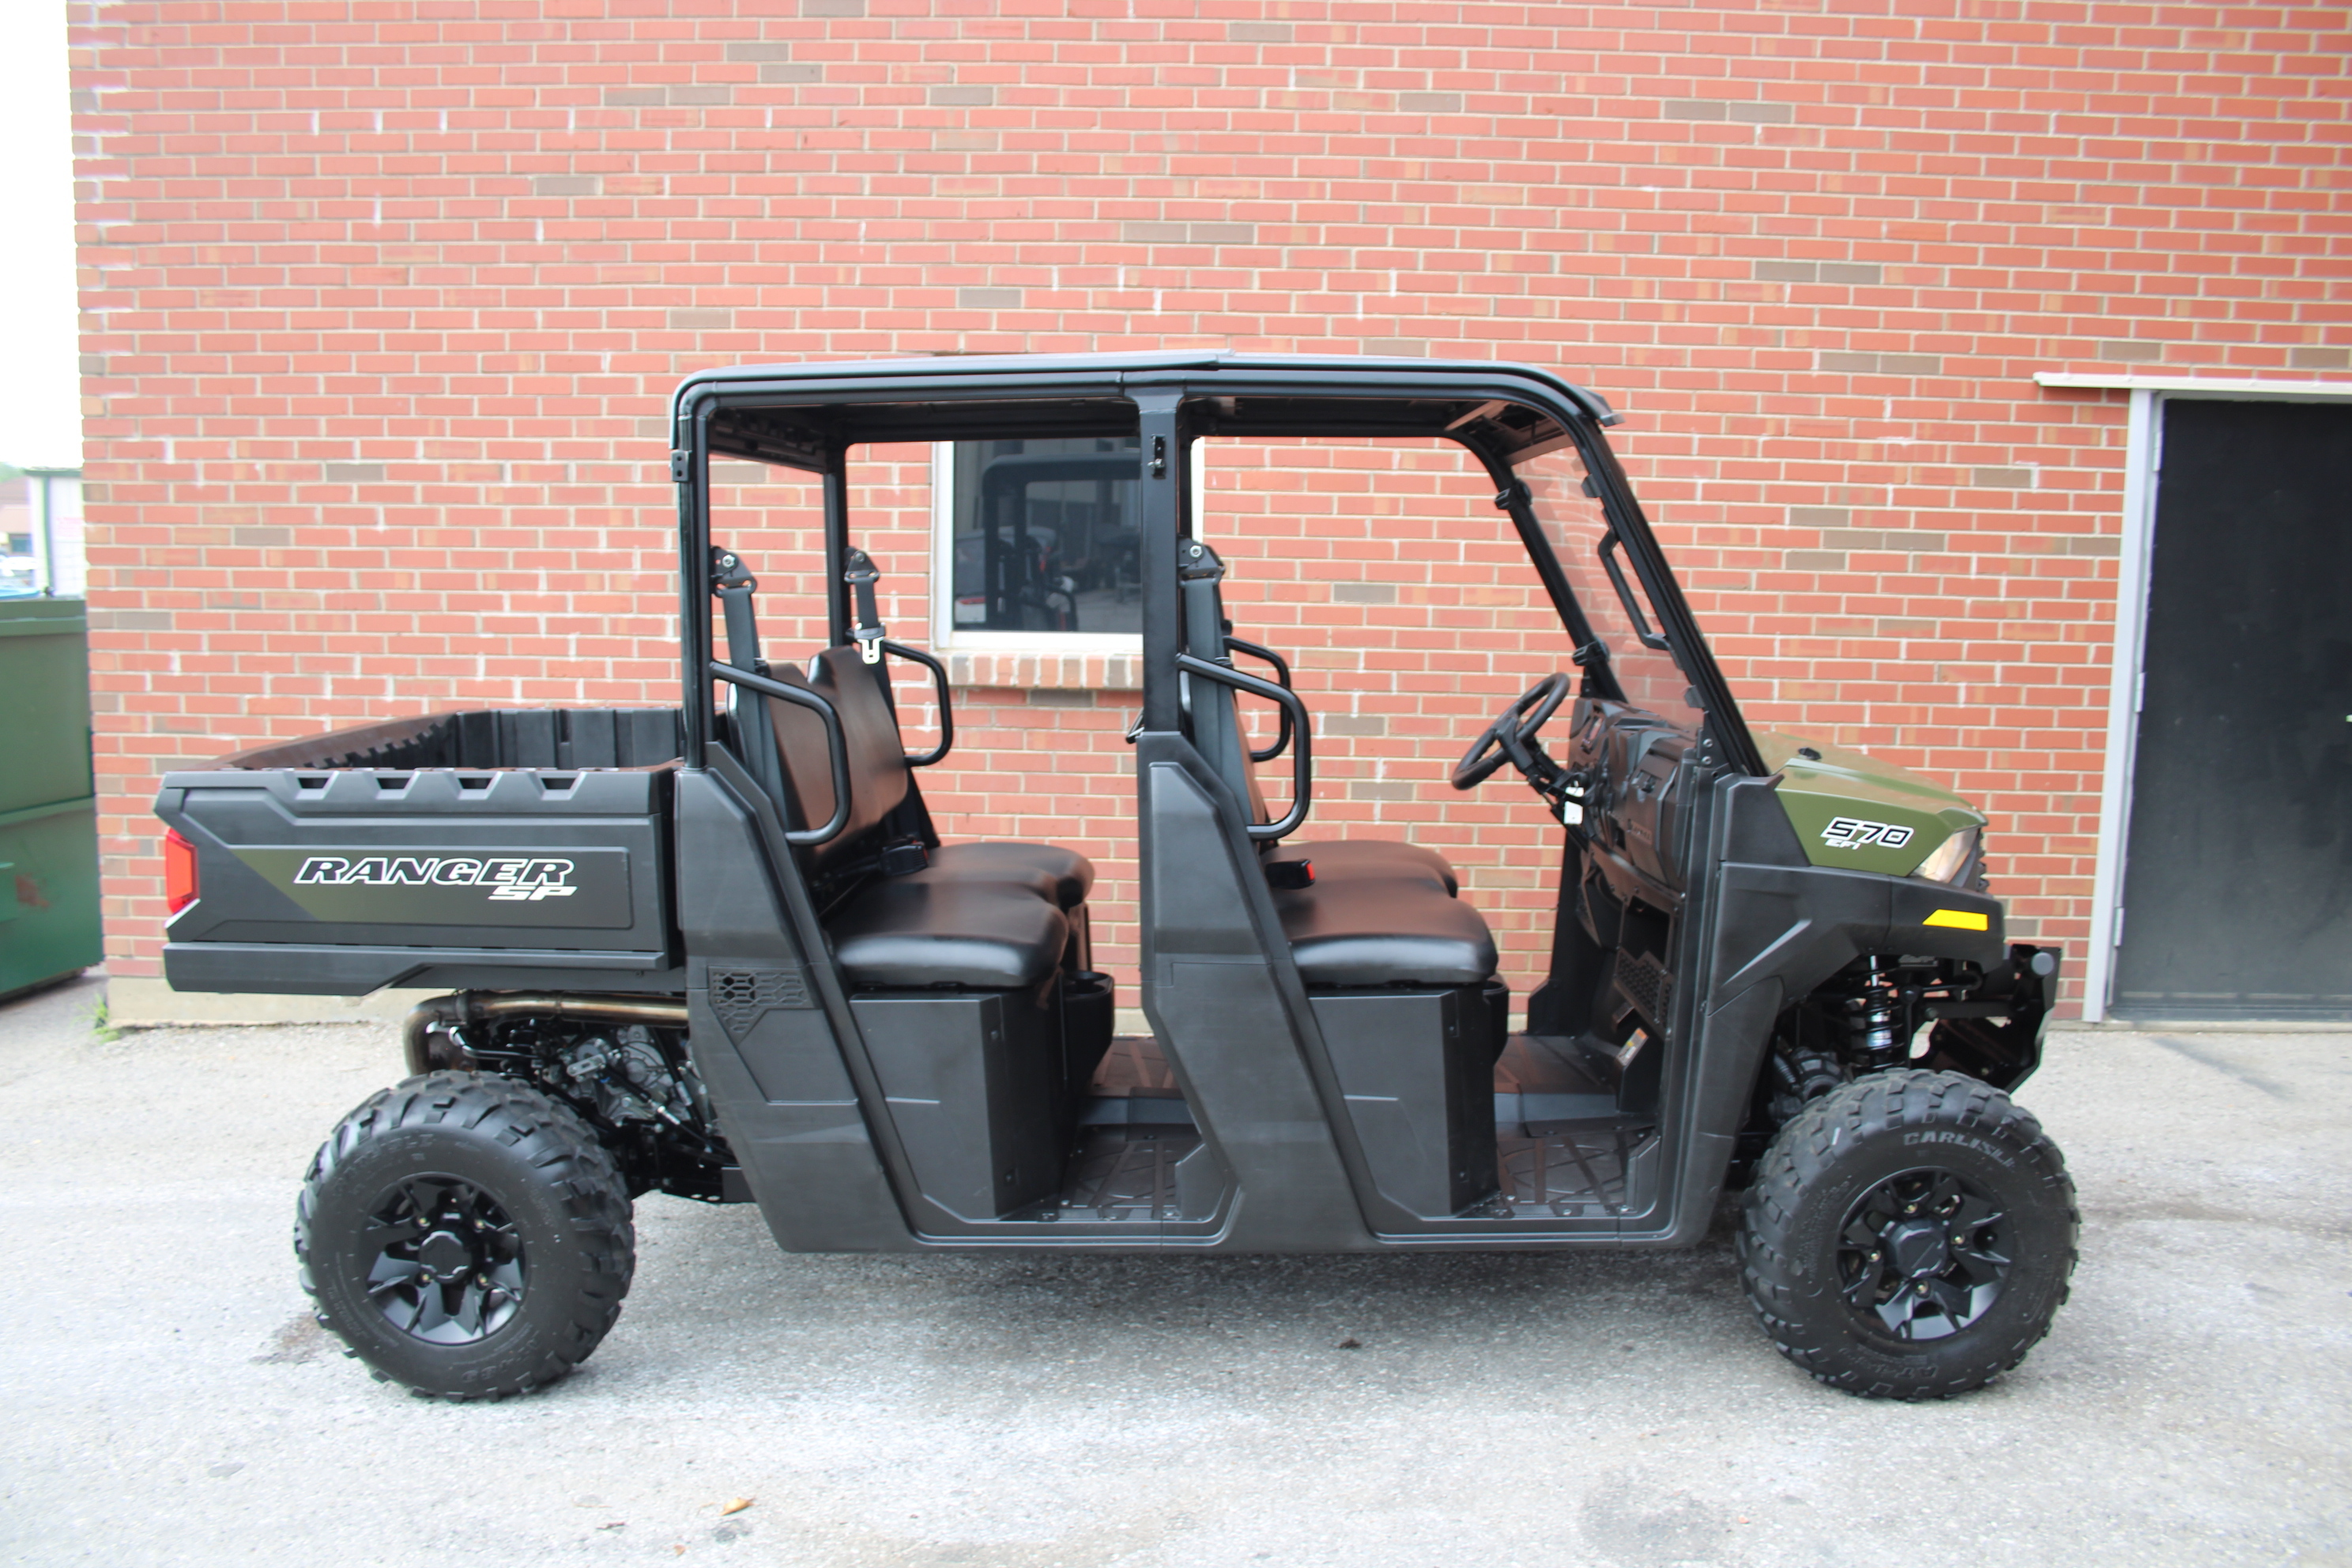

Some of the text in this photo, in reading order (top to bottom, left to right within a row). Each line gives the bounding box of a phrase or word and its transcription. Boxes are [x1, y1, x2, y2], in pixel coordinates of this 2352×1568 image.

[1820, 816, 1914, 849] 570
[1825, 838, 1861, 850] EFI
[293, 857, 574, 885] RANGER
[488, 886, 578, 900] SP
[1903, 1130, 2015, 1170] CARLISLE
